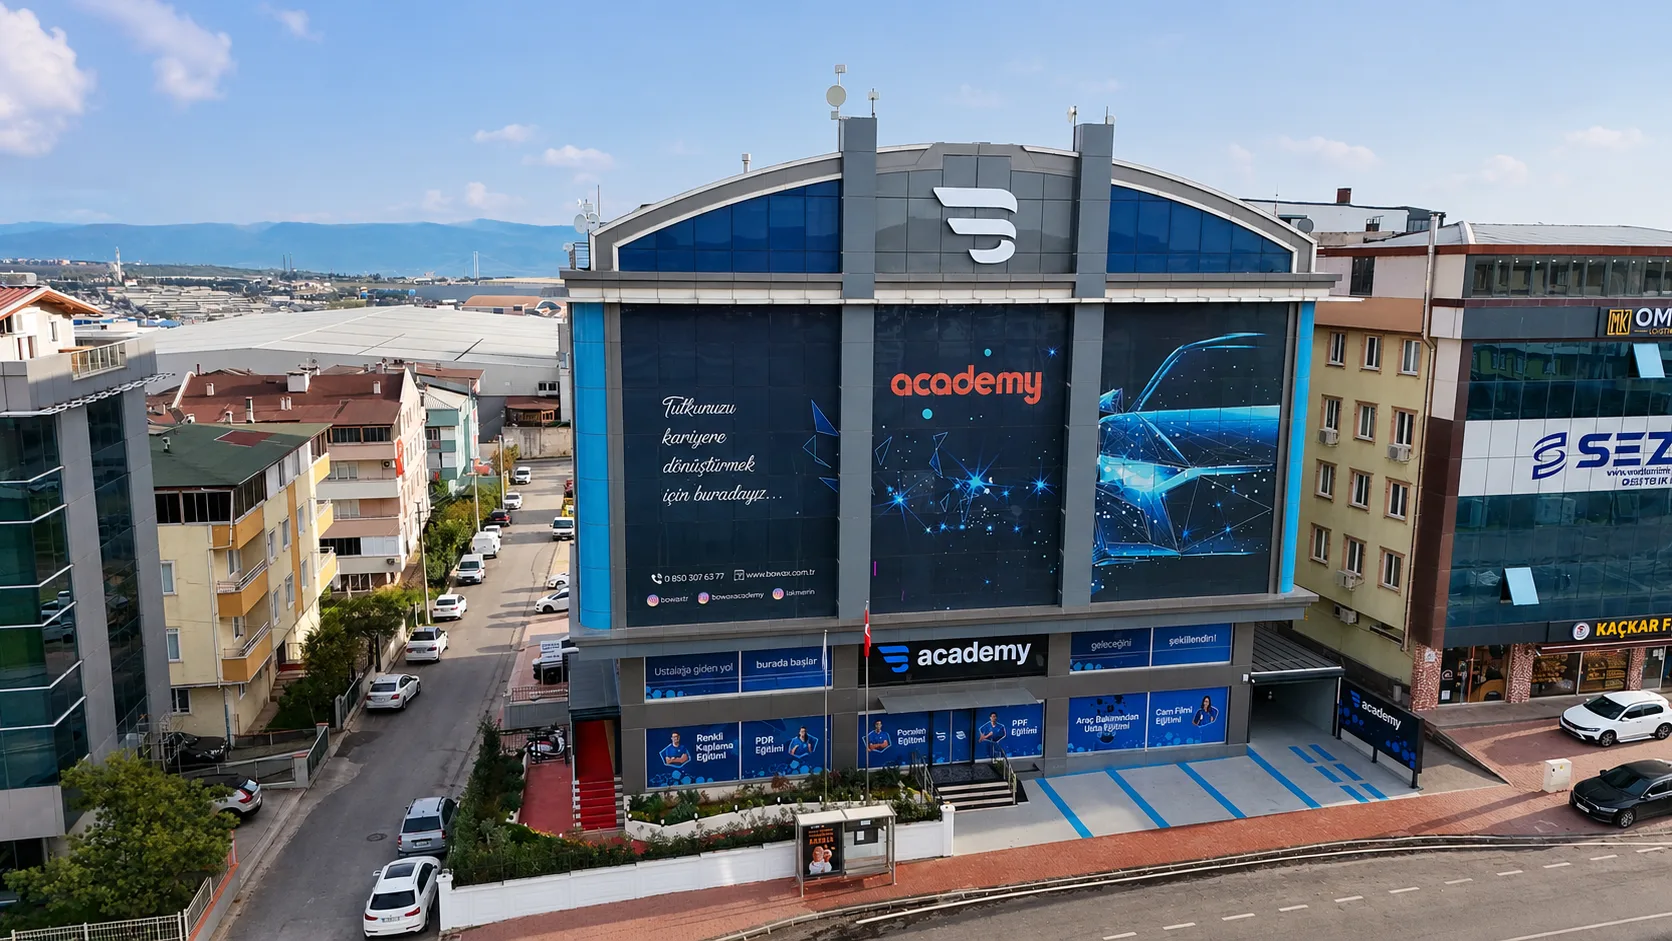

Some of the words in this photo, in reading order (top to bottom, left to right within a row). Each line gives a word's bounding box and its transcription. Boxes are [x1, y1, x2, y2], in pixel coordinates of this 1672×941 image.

[890, 364, 1043, 405] academy
[662, 395, 736, 418] Tutkunuzu
[661, 427, 727, 449] kariyere
[662, 454, 755, 477] dönüştürmek
[662, 487, 690, 506] için
[664, 575, 670, 583] 0
[671, 574, 687, 582] 850
[688, 572, 703, 581] 307
[1596, 619, 1659, 639] KAÇKAR
[756, 660, 788, 669] burada
[790, 657, 818, 668] başlar
[917, 641, 1032, 666] academy
[693, 663, 718, 676] giden
[720, 662, 734, 674] yol
[1361, 700, 1402, 731] academy
[755, 735, 774, 745] PDR
